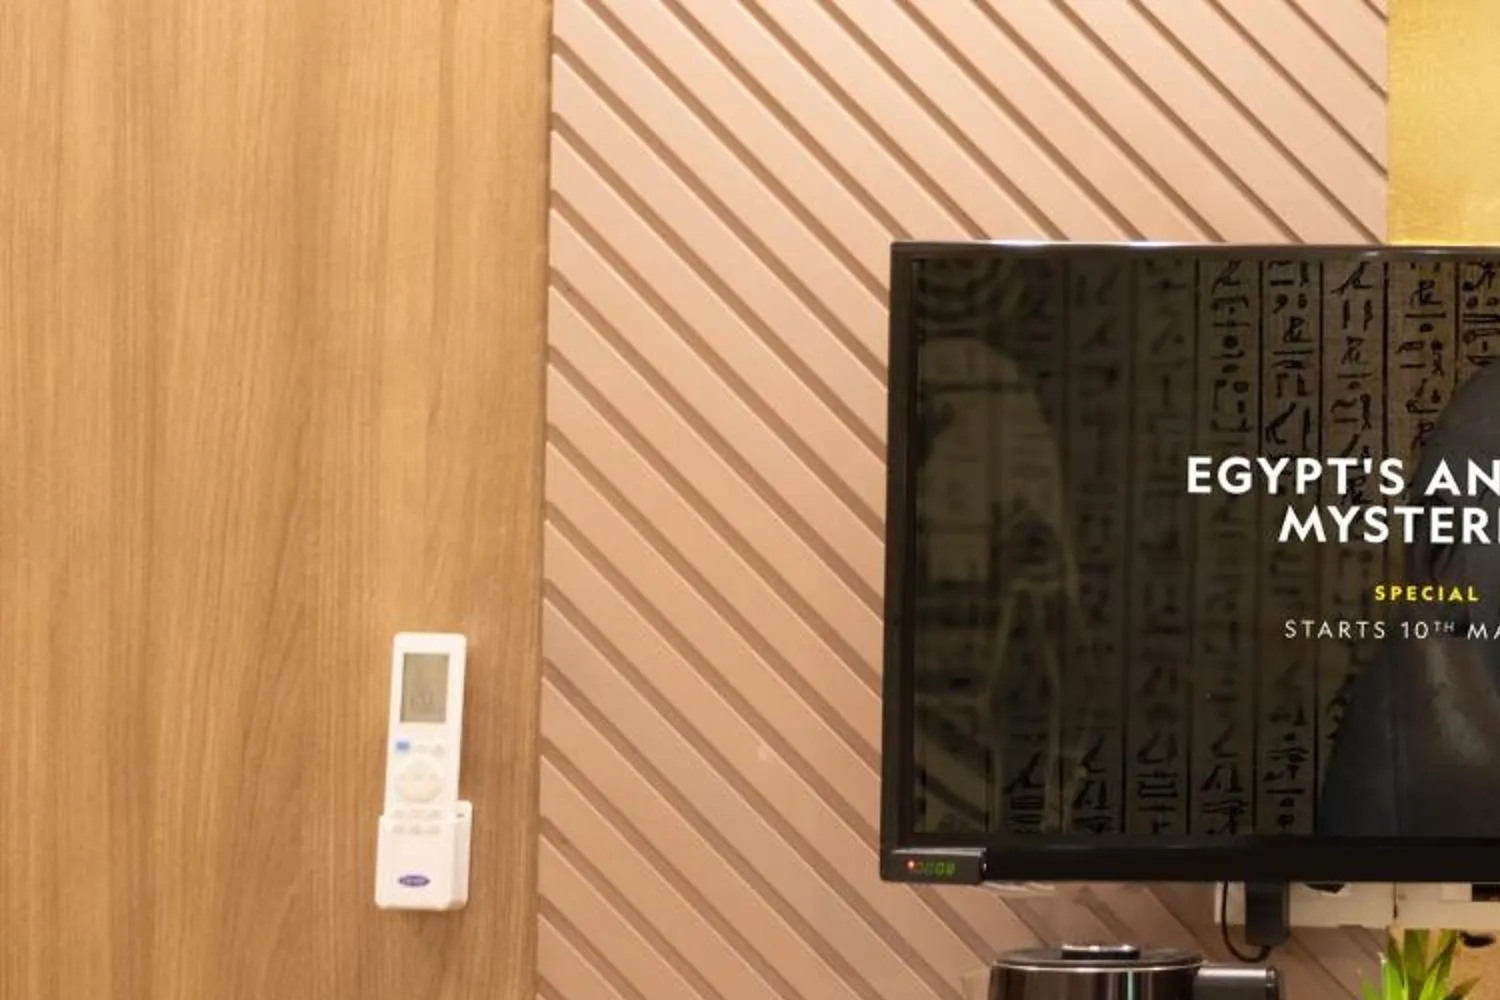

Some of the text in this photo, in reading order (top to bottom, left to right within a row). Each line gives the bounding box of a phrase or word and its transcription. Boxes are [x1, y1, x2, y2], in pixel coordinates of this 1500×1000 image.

[1186, 456, 1405, 496] EGYPT'S
[1374, 585, 1480, 602] SPECIAL
[1284, 619, 1386, 640] STARTS
